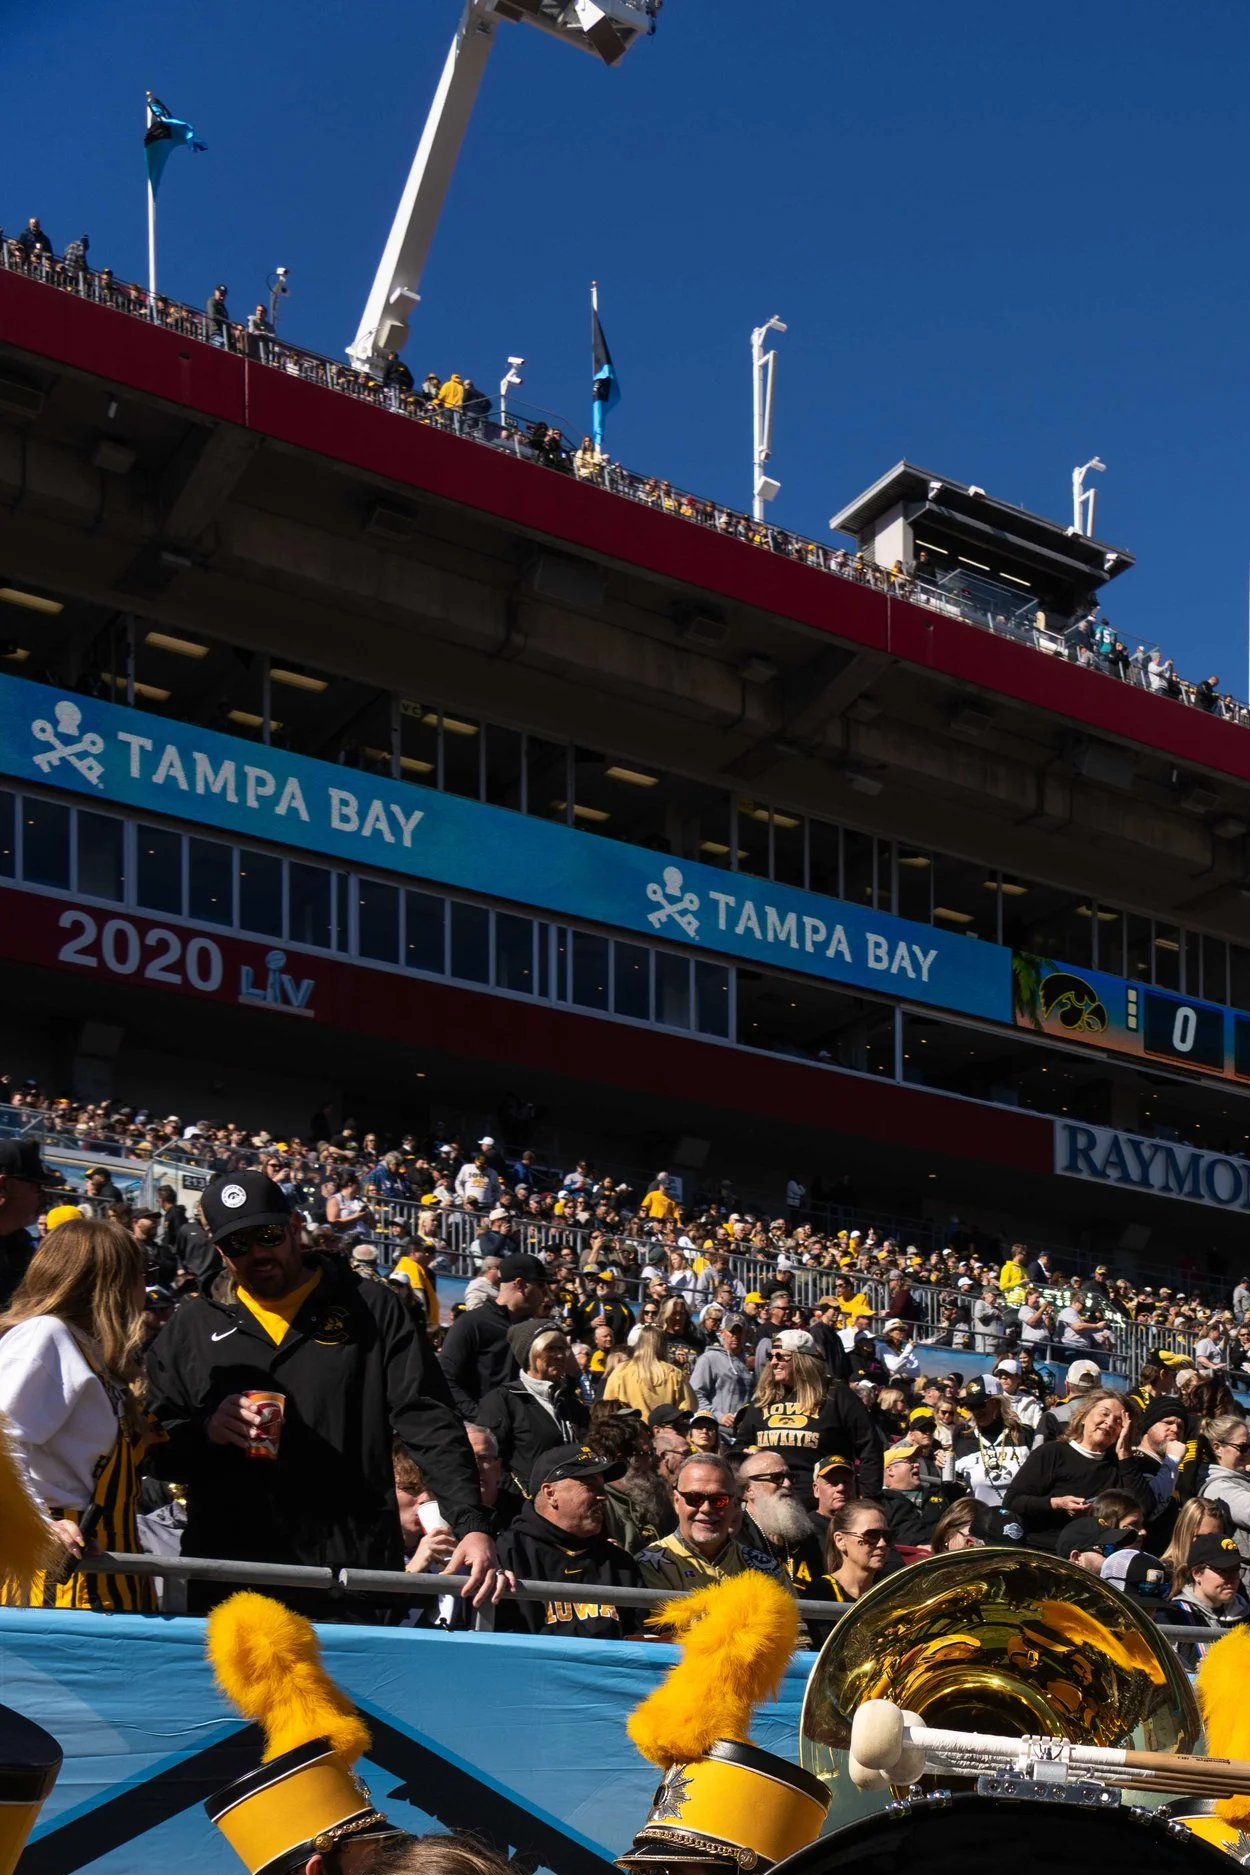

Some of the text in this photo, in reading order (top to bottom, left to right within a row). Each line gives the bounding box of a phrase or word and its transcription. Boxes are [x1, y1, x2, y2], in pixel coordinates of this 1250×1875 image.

[117, 731, 424, 848] TAMPA BAY
[57, 910, 223, 992] 2020
[709, 891, 938, 982] TAMPA BAY
[1171, 1006, 1197, 1053] 0
[757, 1430, 820, 1448] HAWKEYES
